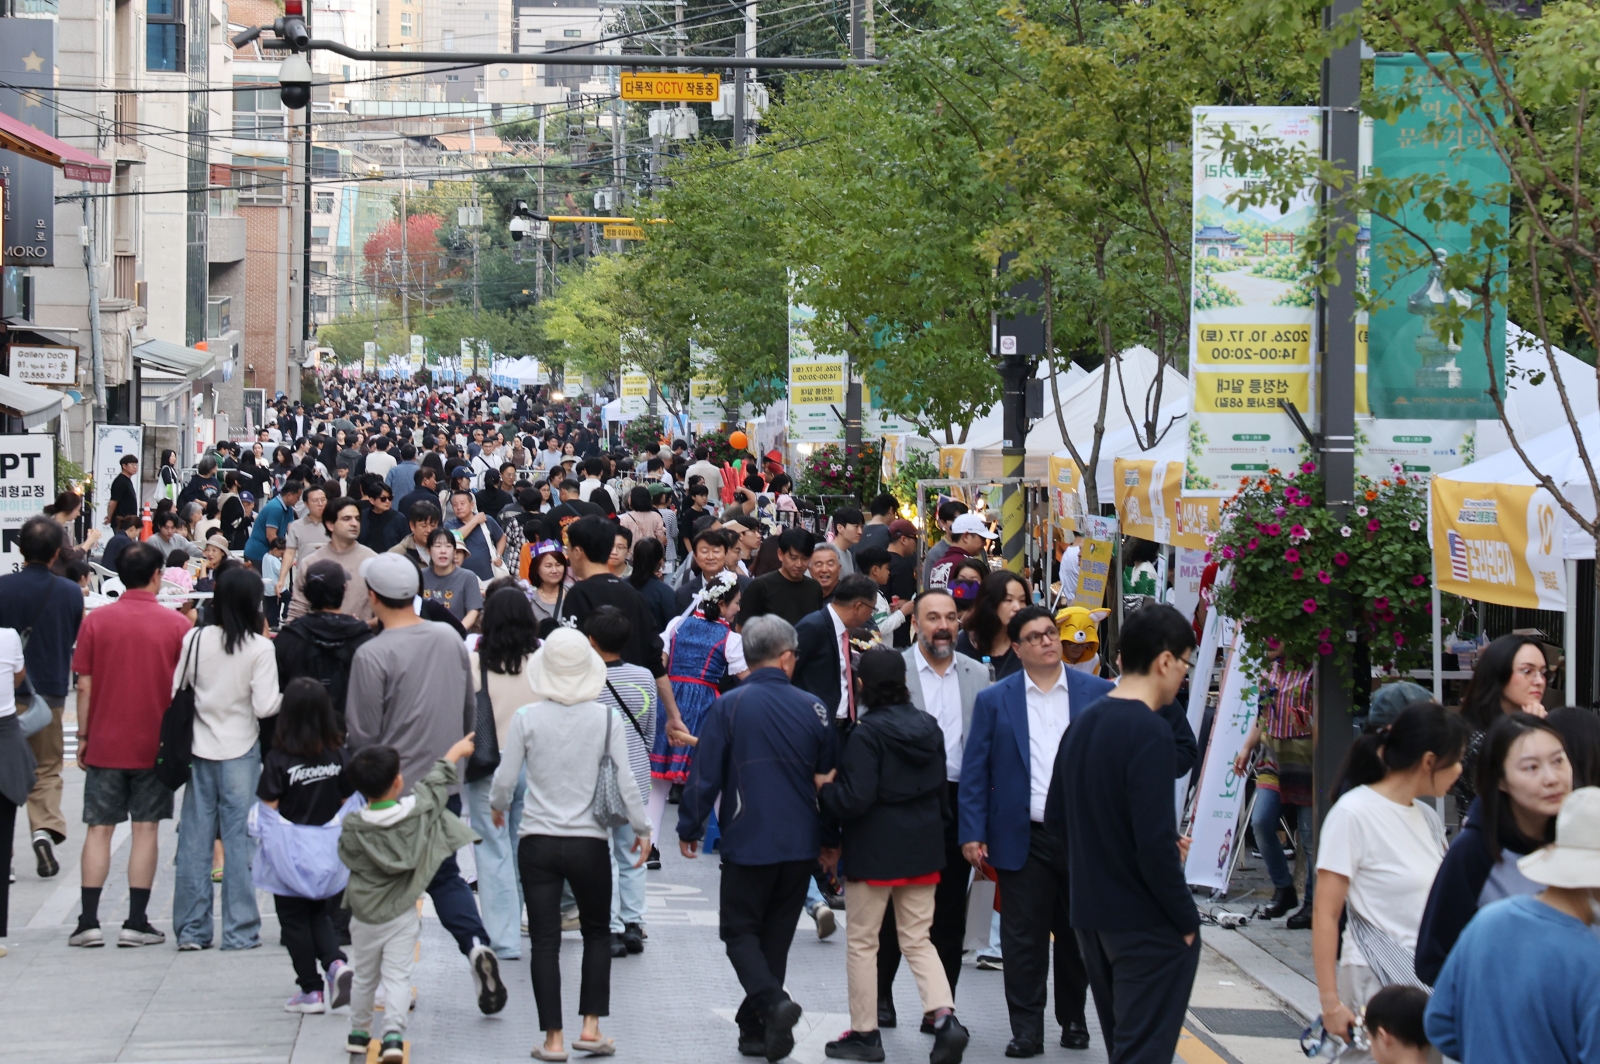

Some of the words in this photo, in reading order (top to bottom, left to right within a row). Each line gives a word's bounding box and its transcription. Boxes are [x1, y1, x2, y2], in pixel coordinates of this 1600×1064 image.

[625, 81, 653, 94] 다목적
[655, 81, 683, 94] CCTV
[686, 82, 714, 96] 작동중
[3, 246, 47, 257] MORO
[0, 453, 41, 479] PT
